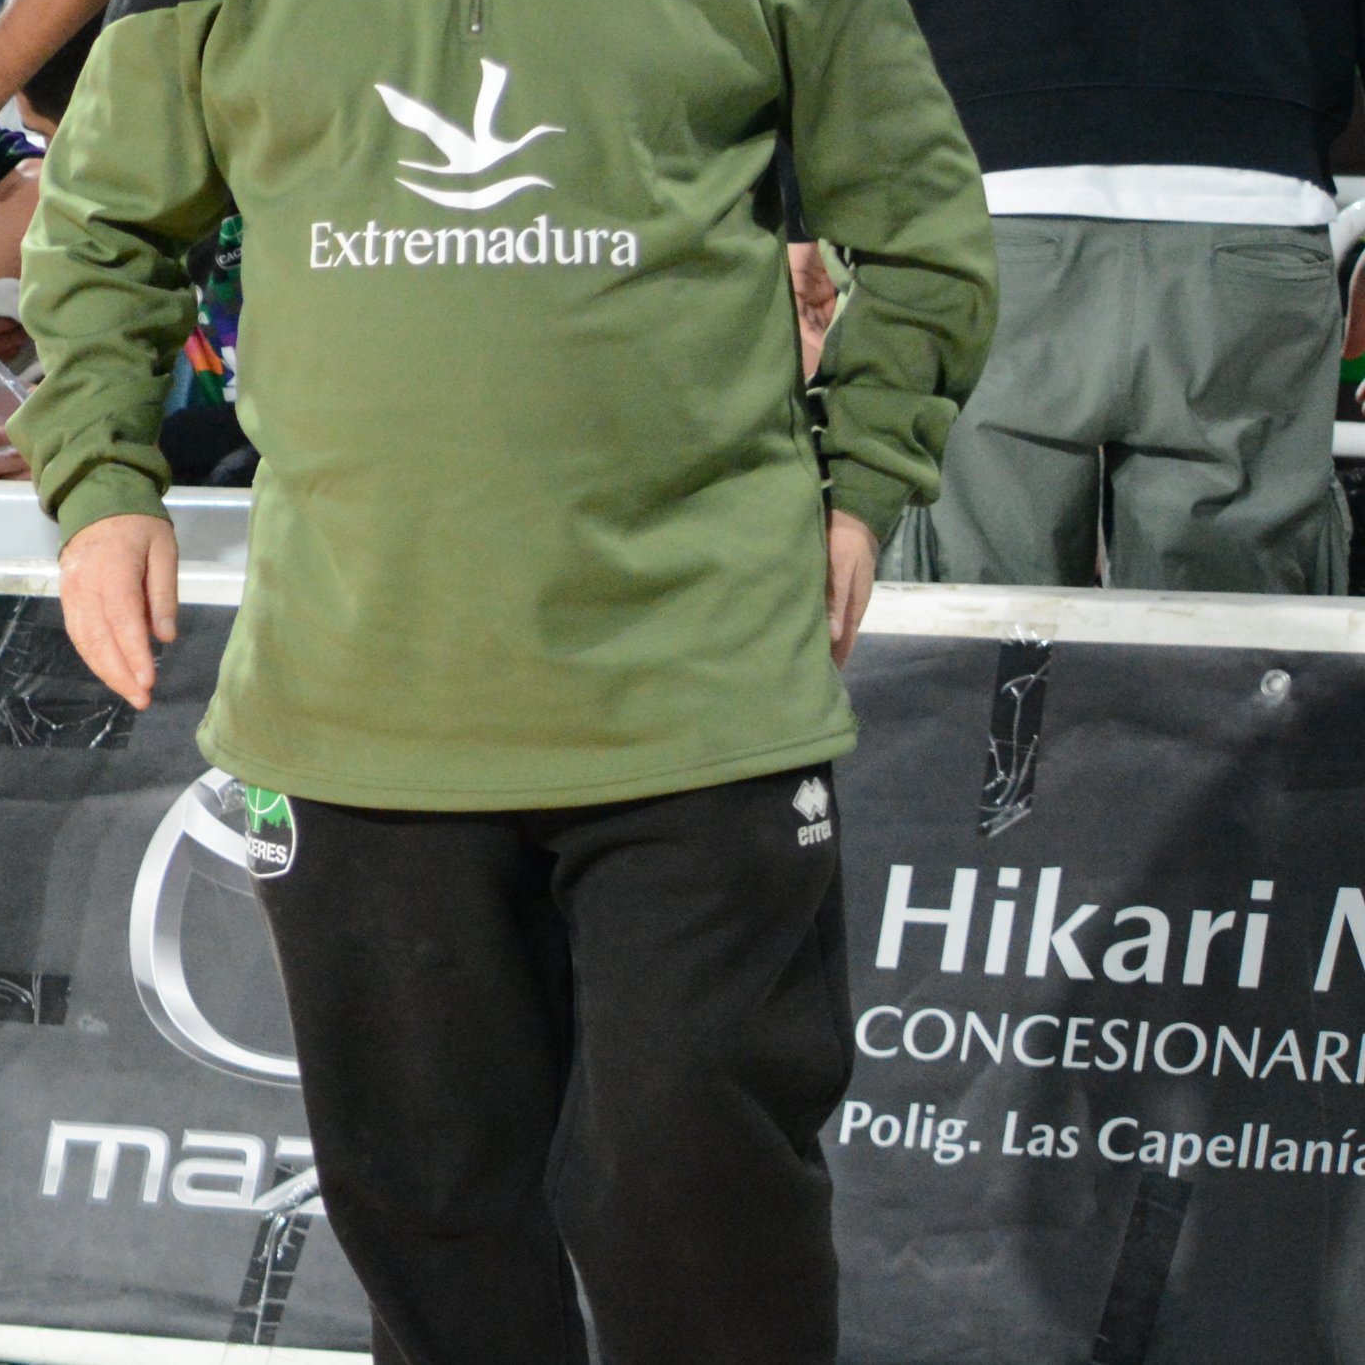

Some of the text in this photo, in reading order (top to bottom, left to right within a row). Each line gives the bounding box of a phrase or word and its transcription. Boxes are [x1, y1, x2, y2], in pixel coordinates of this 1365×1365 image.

[310, 214, 637, 269] Extremadura
[875, 864, 1275, 990] Hikari
[838, 1100, 982, 1165] Polig.
[1001, 1110, 1080, 1160] Las
